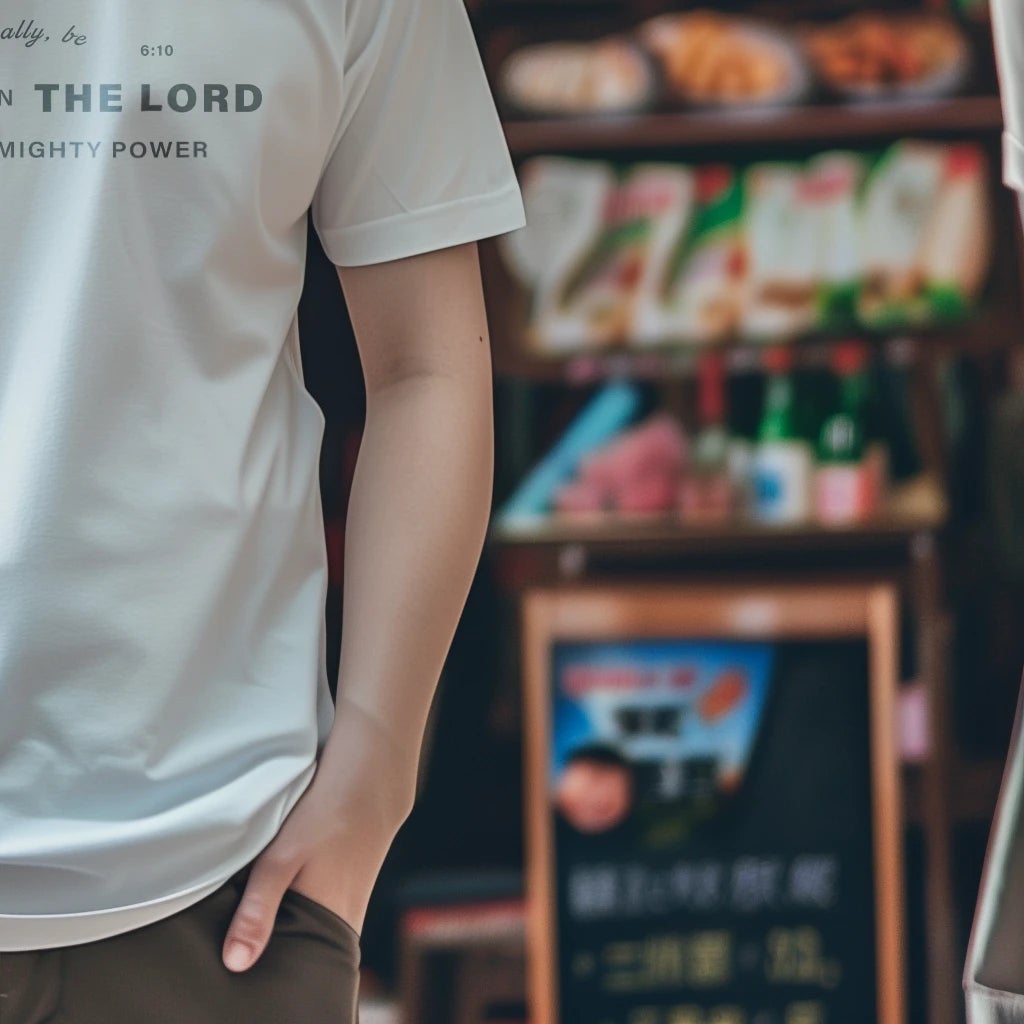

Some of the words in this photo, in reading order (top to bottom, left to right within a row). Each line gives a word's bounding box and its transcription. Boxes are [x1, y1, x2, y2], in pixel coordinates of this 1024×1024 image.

[61, 24, 87, 46] be
[140, 44, 174, 57] 6:10
[34, 83, 124, 113] THE
[140, 83, 263, 113] LORD
[112, 141, 207, 159] POWER
